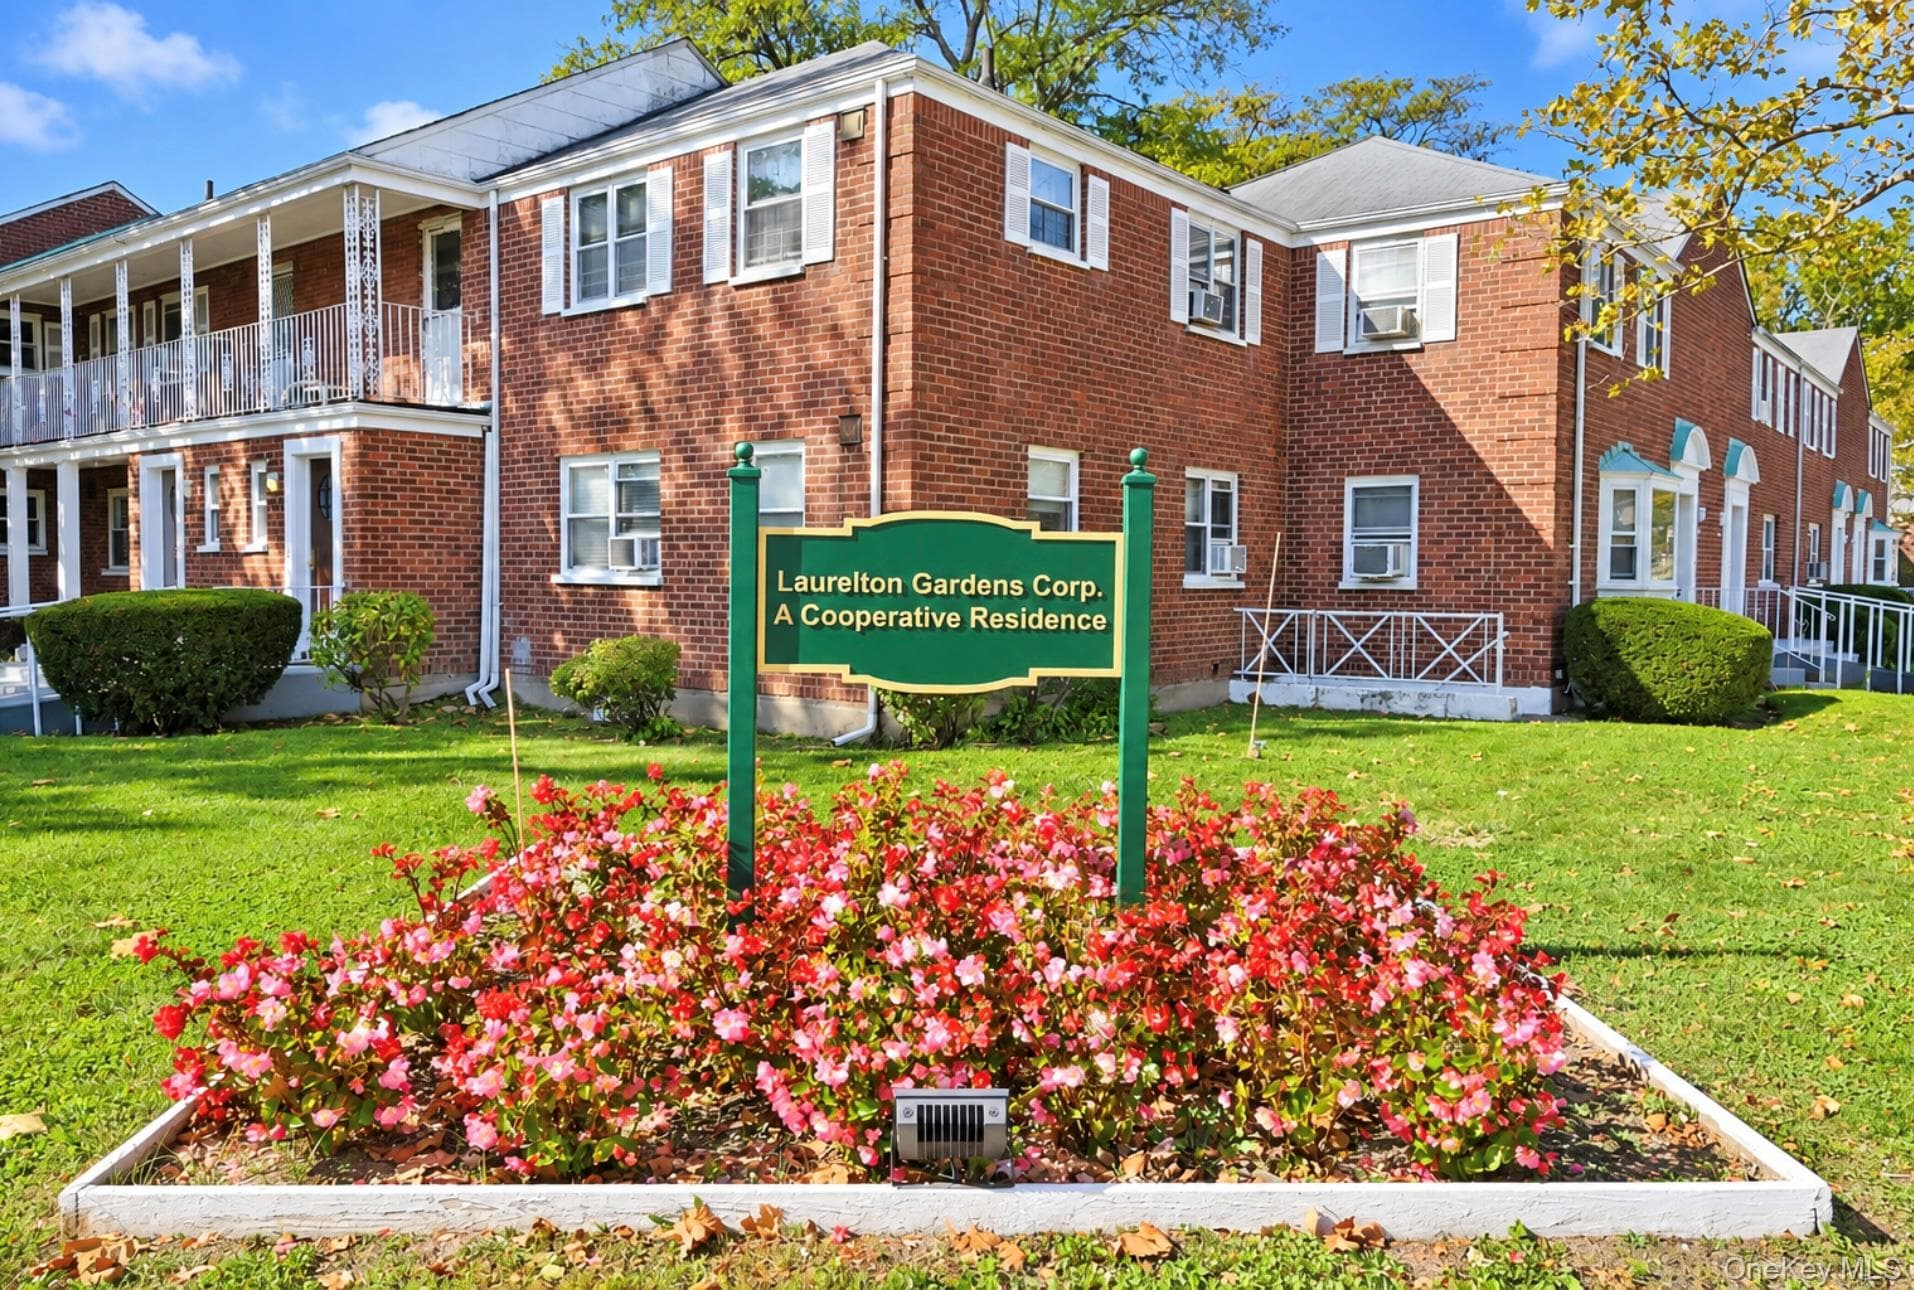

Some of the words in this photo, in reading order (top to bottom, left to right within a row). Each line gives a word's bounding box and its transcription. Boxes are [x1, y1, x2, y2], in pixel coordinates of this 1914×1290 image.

[777, 570, 903, 593] Laurelton
[911, 572, 1024, 597] Gardens
[1032, 575, 1103, 602] Corp.
[773, 603, 794, 625] A
[800, 603, 961, 632] Cooperative
[969, 607, 1107, 630] Residence
